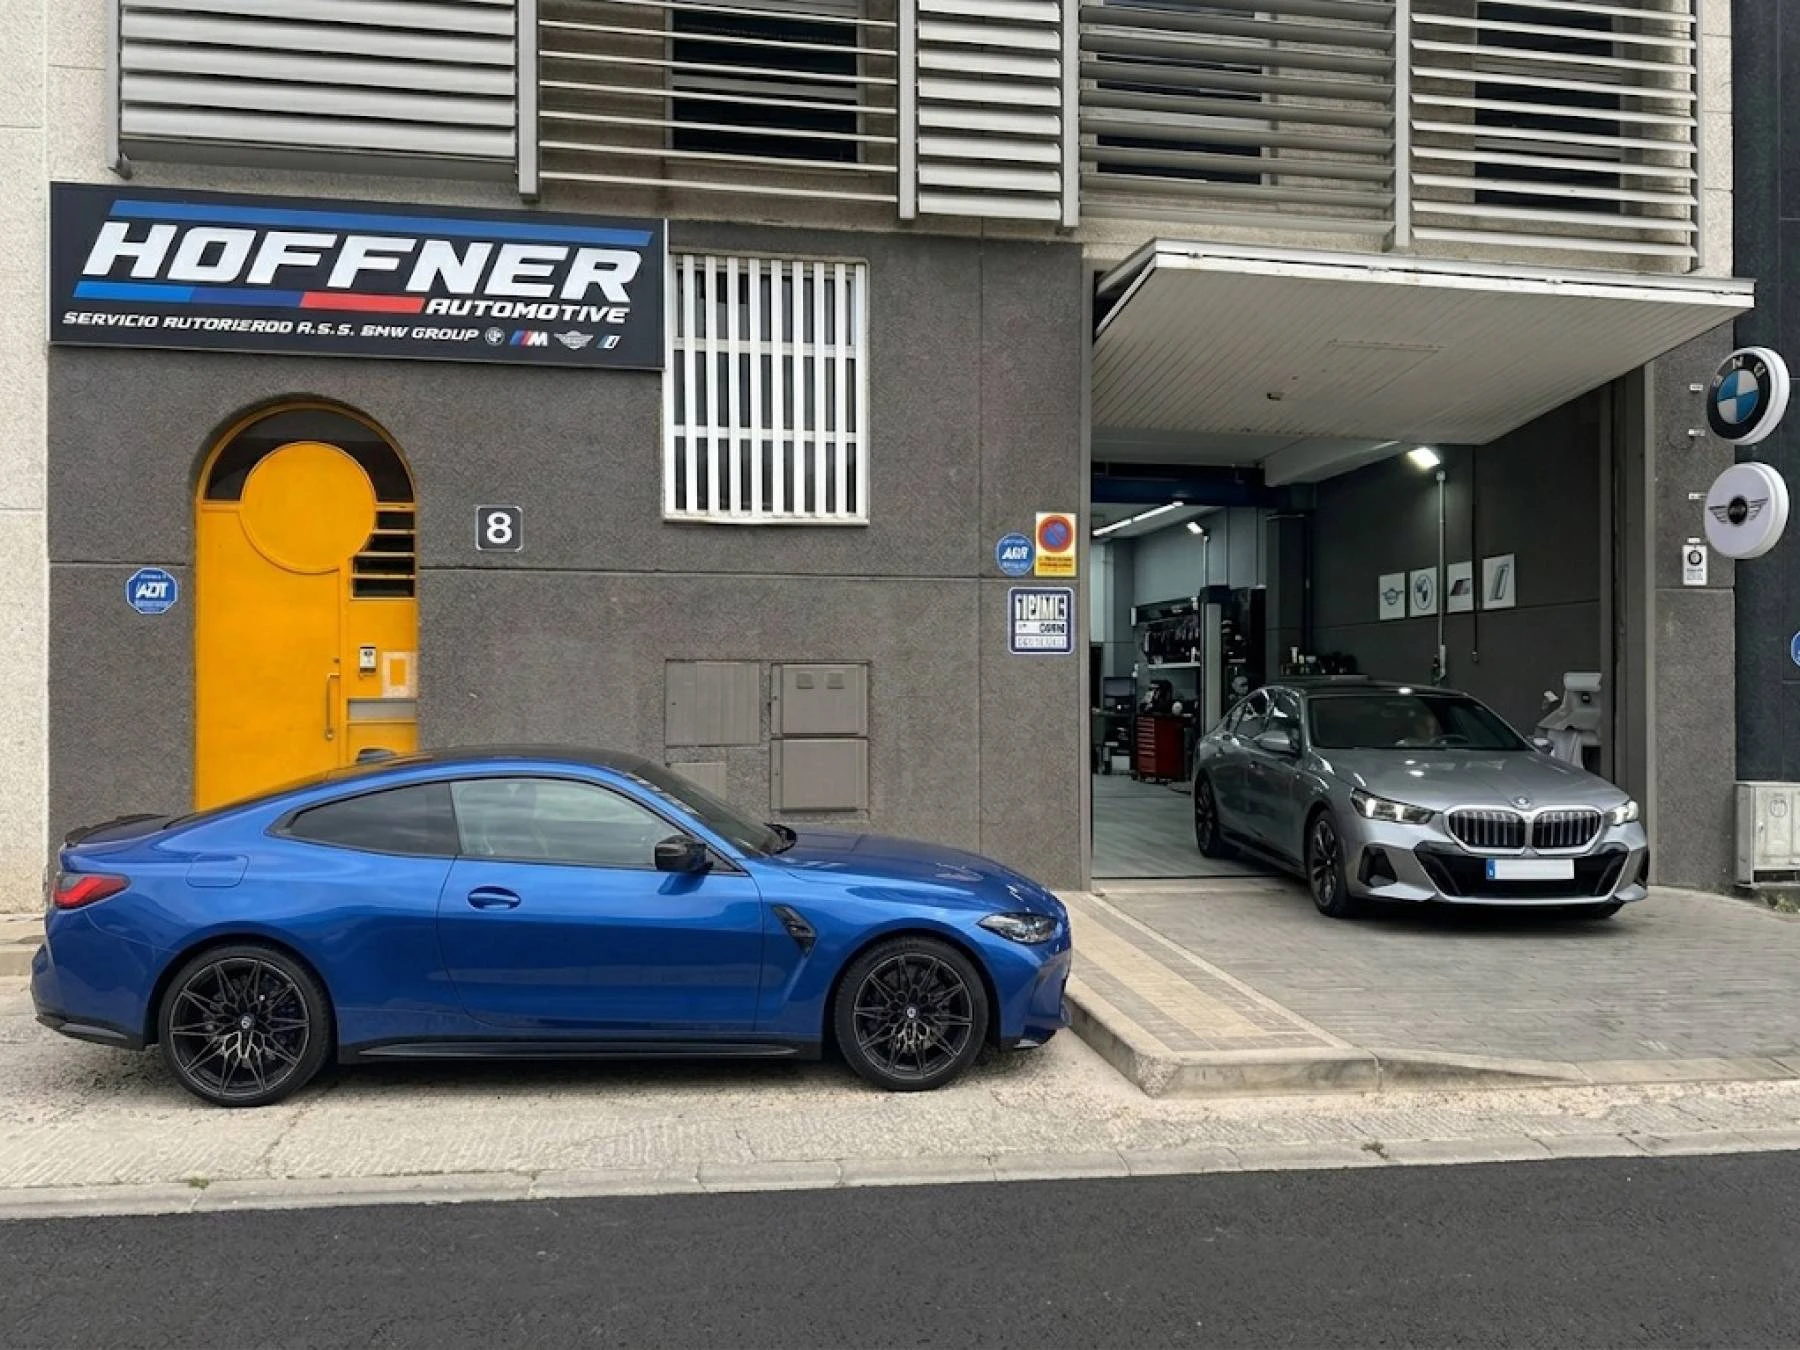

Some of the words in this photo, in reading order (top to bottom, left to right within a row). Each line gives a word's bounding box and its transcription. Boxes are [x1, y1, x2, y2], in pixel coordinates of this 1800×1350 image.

[81, 221, 642, 302] HOFFNER
[62, 311, 159, 329] SERVICIO
[411, 326, 480, 341] GROUP
[425, 299, 631, 324] AUTOMOTIVE
[487, 511, 512, 544] 8
[135, 581, 169, 599] ADT
